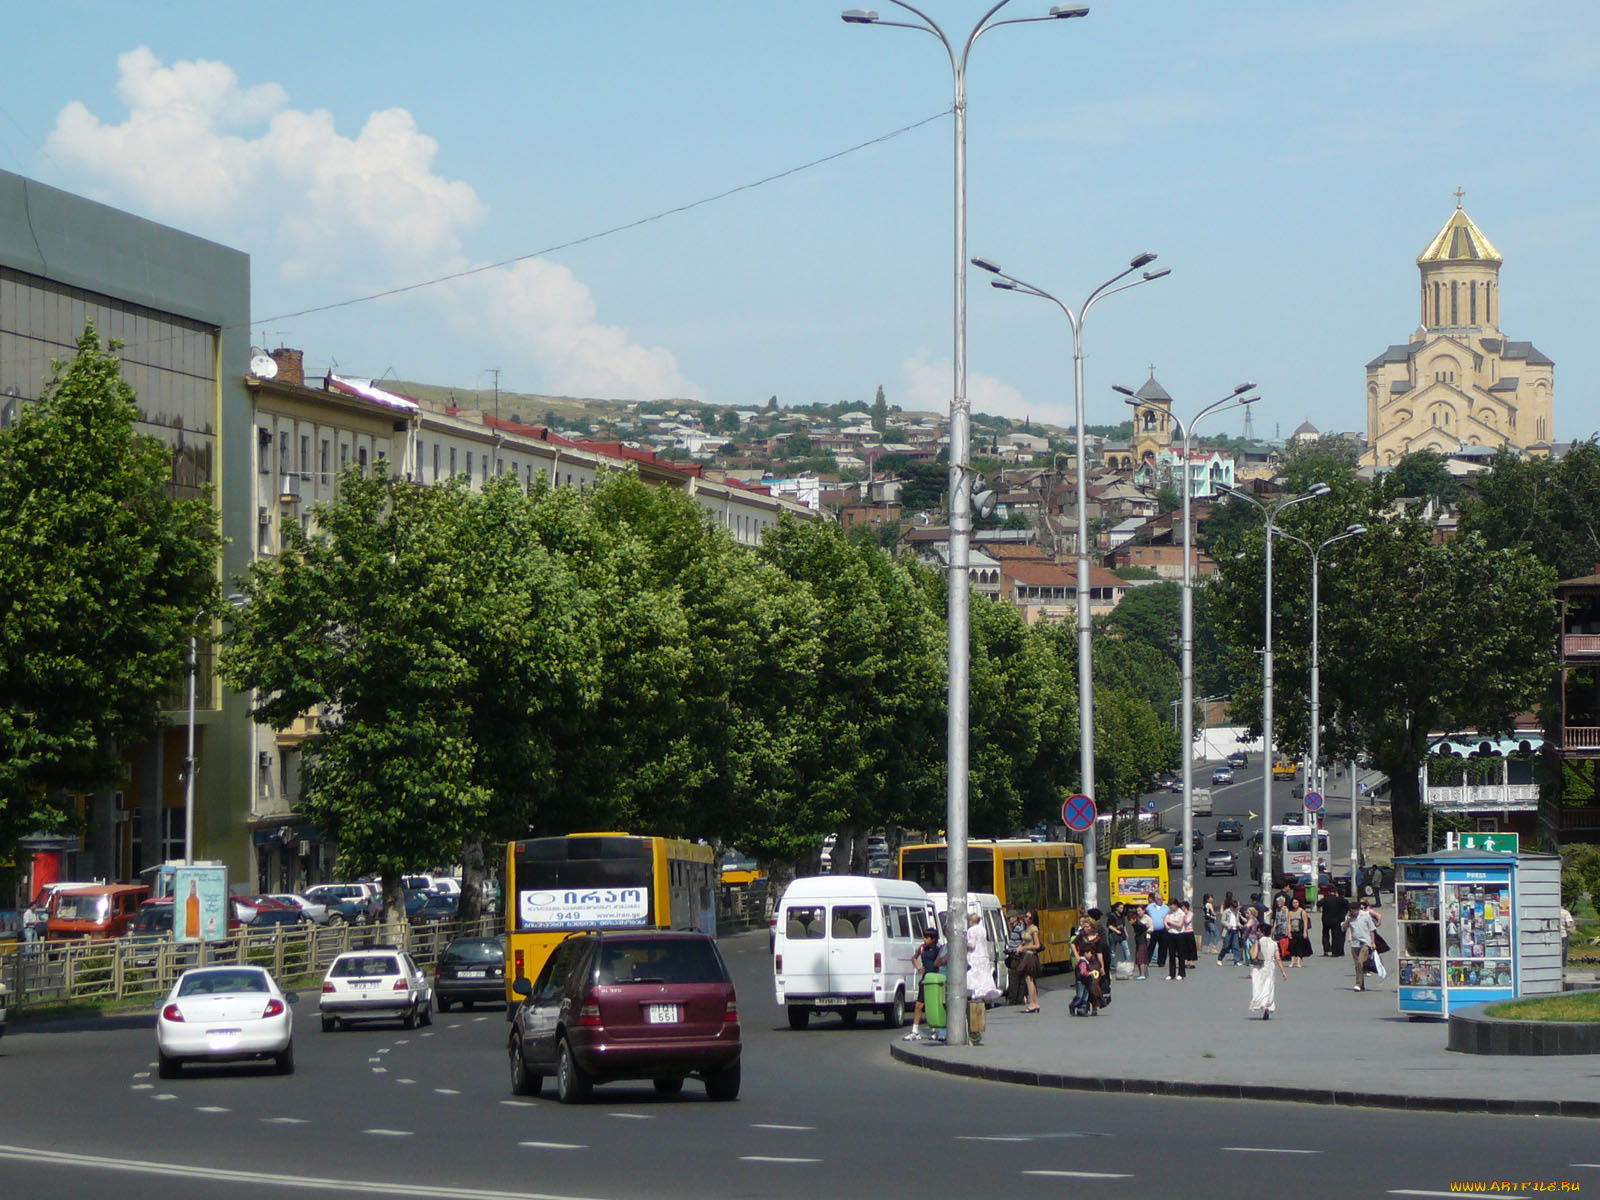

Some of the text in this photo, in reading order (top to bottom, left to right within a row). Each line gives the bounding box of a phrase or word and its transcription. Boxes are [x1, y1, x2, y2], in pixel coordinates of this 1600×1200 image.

[564, 890, 640, 904] ირაო
[556, 912, 581, 920] 949
[658, 1012, 675, 1021] 551
